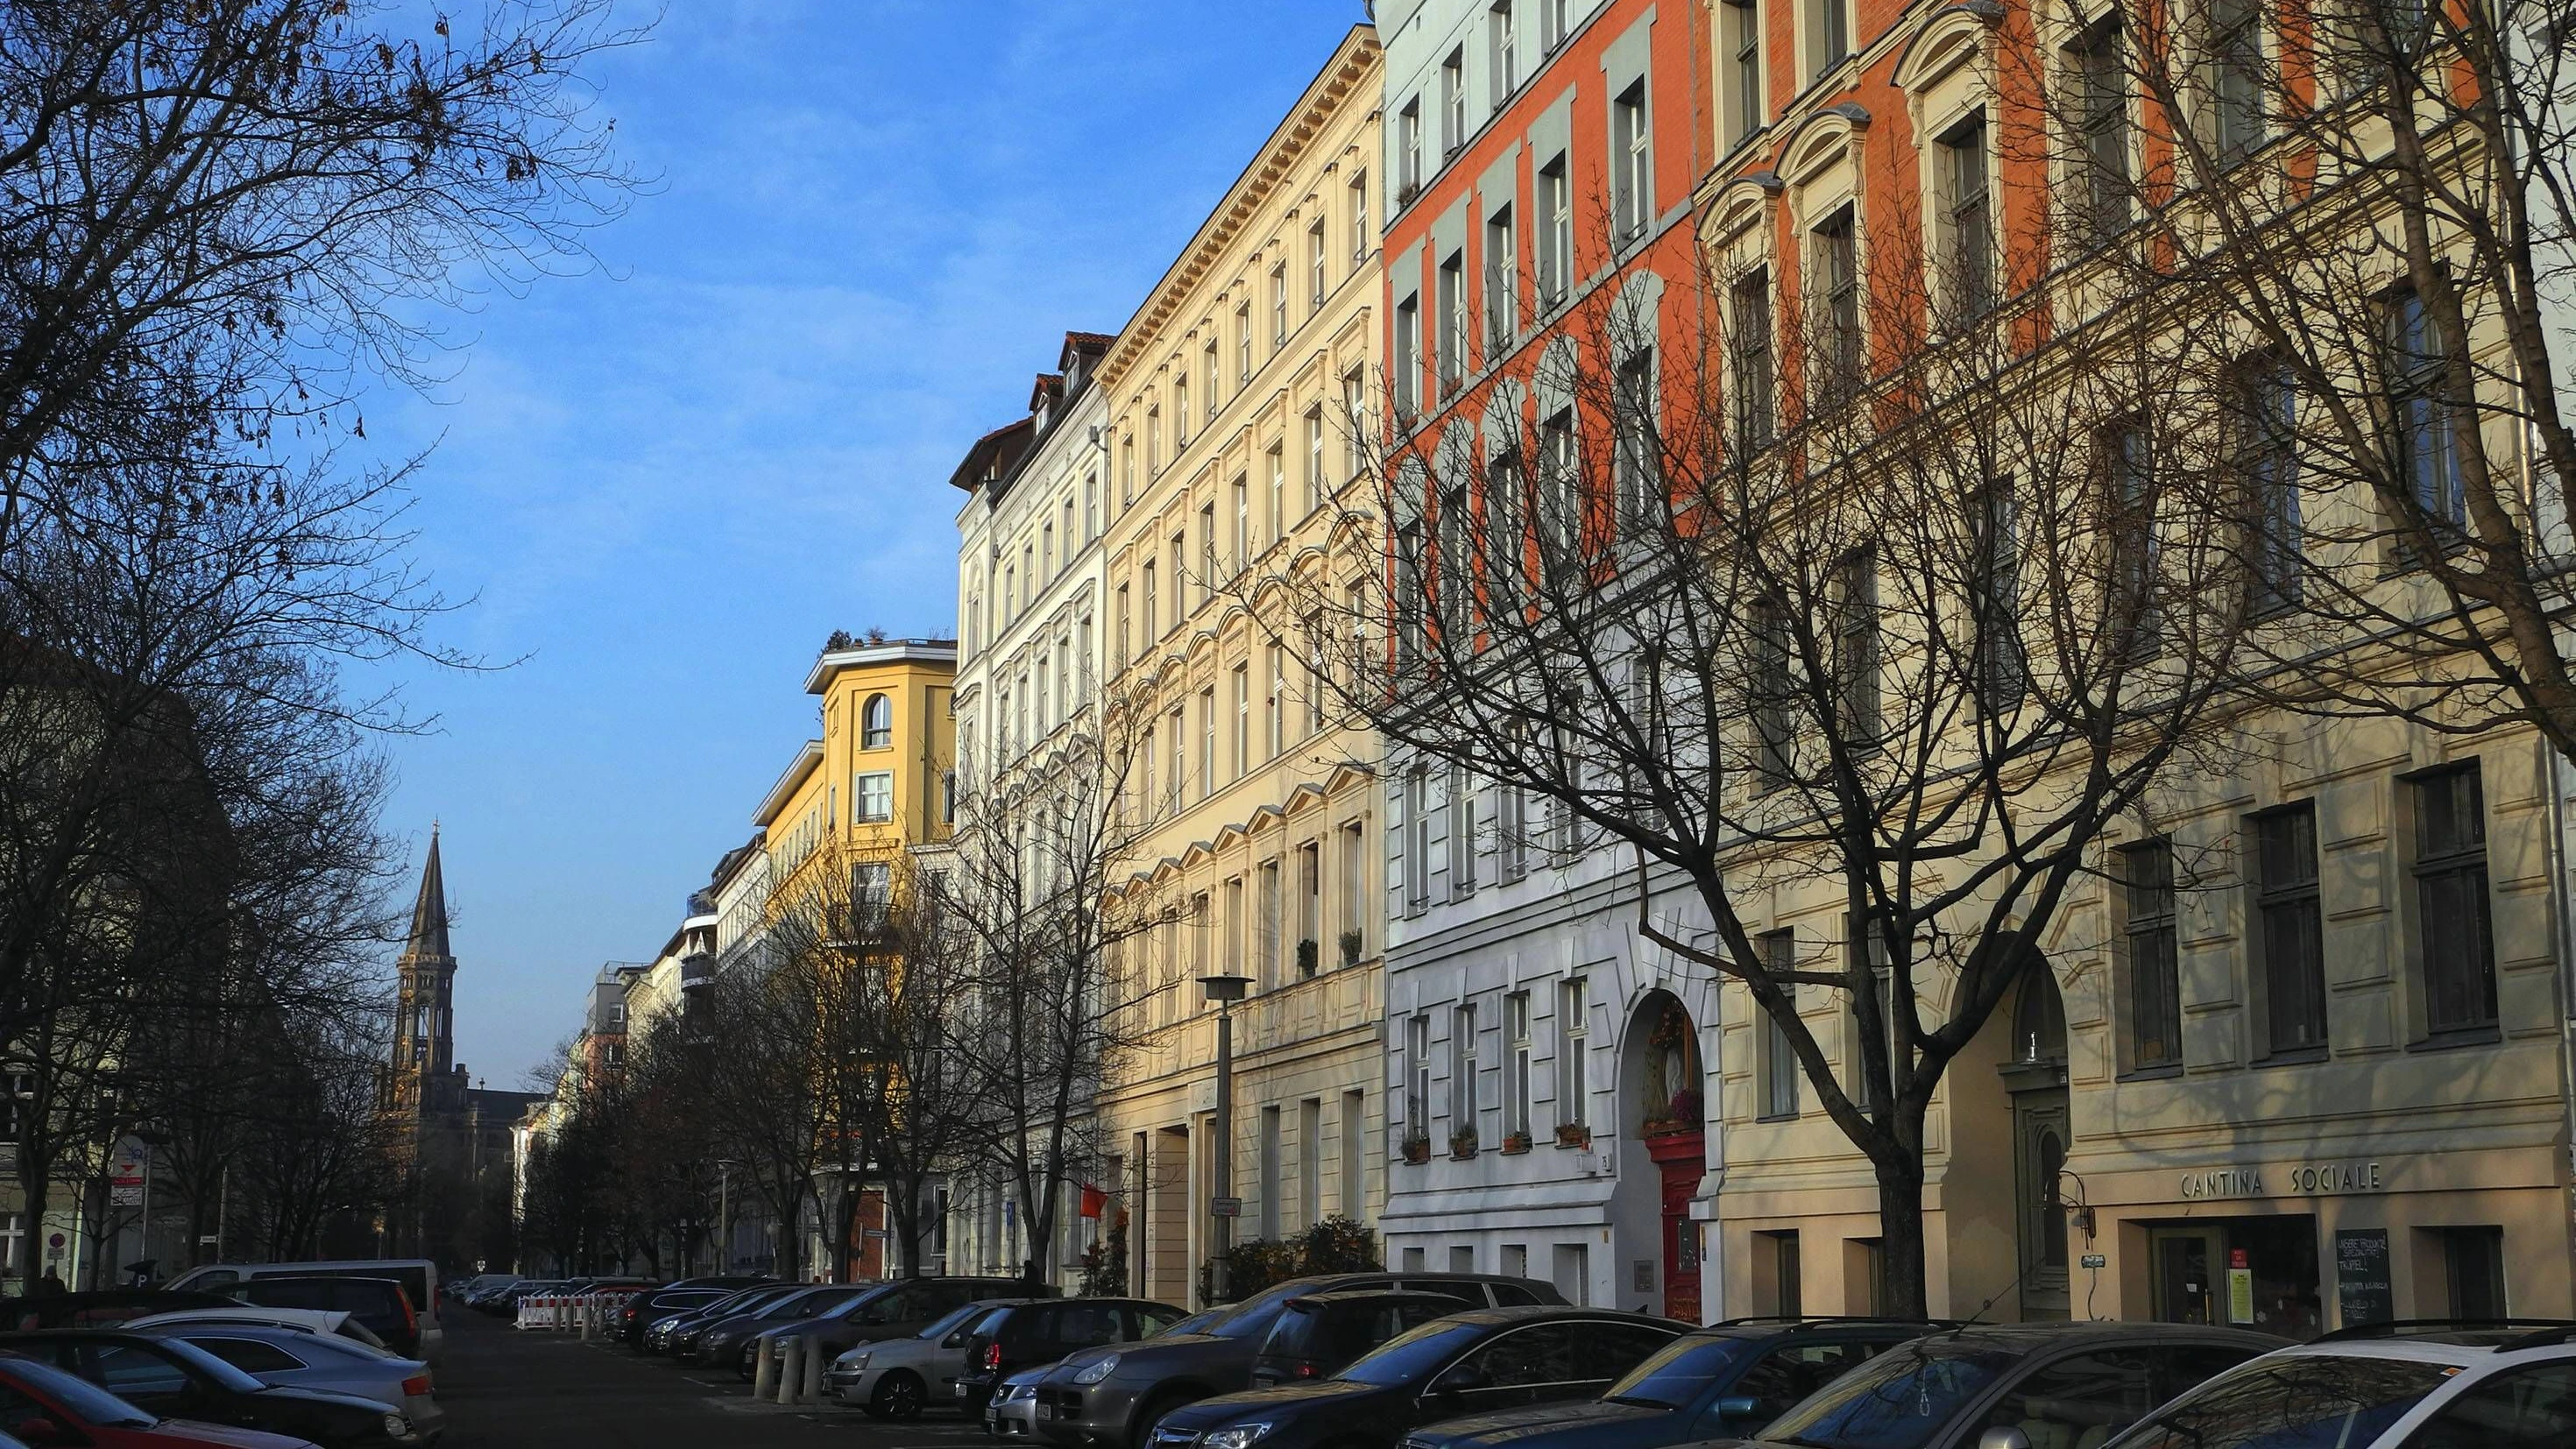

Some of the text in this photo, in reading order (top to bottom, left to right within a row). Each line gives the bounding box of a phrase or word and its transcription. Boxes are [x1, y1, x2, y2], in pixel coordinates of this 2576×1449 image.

[2181, 1163, 2381, 1198] CANTINA SOCIALE
[138, 1274, 147, 1288] P
